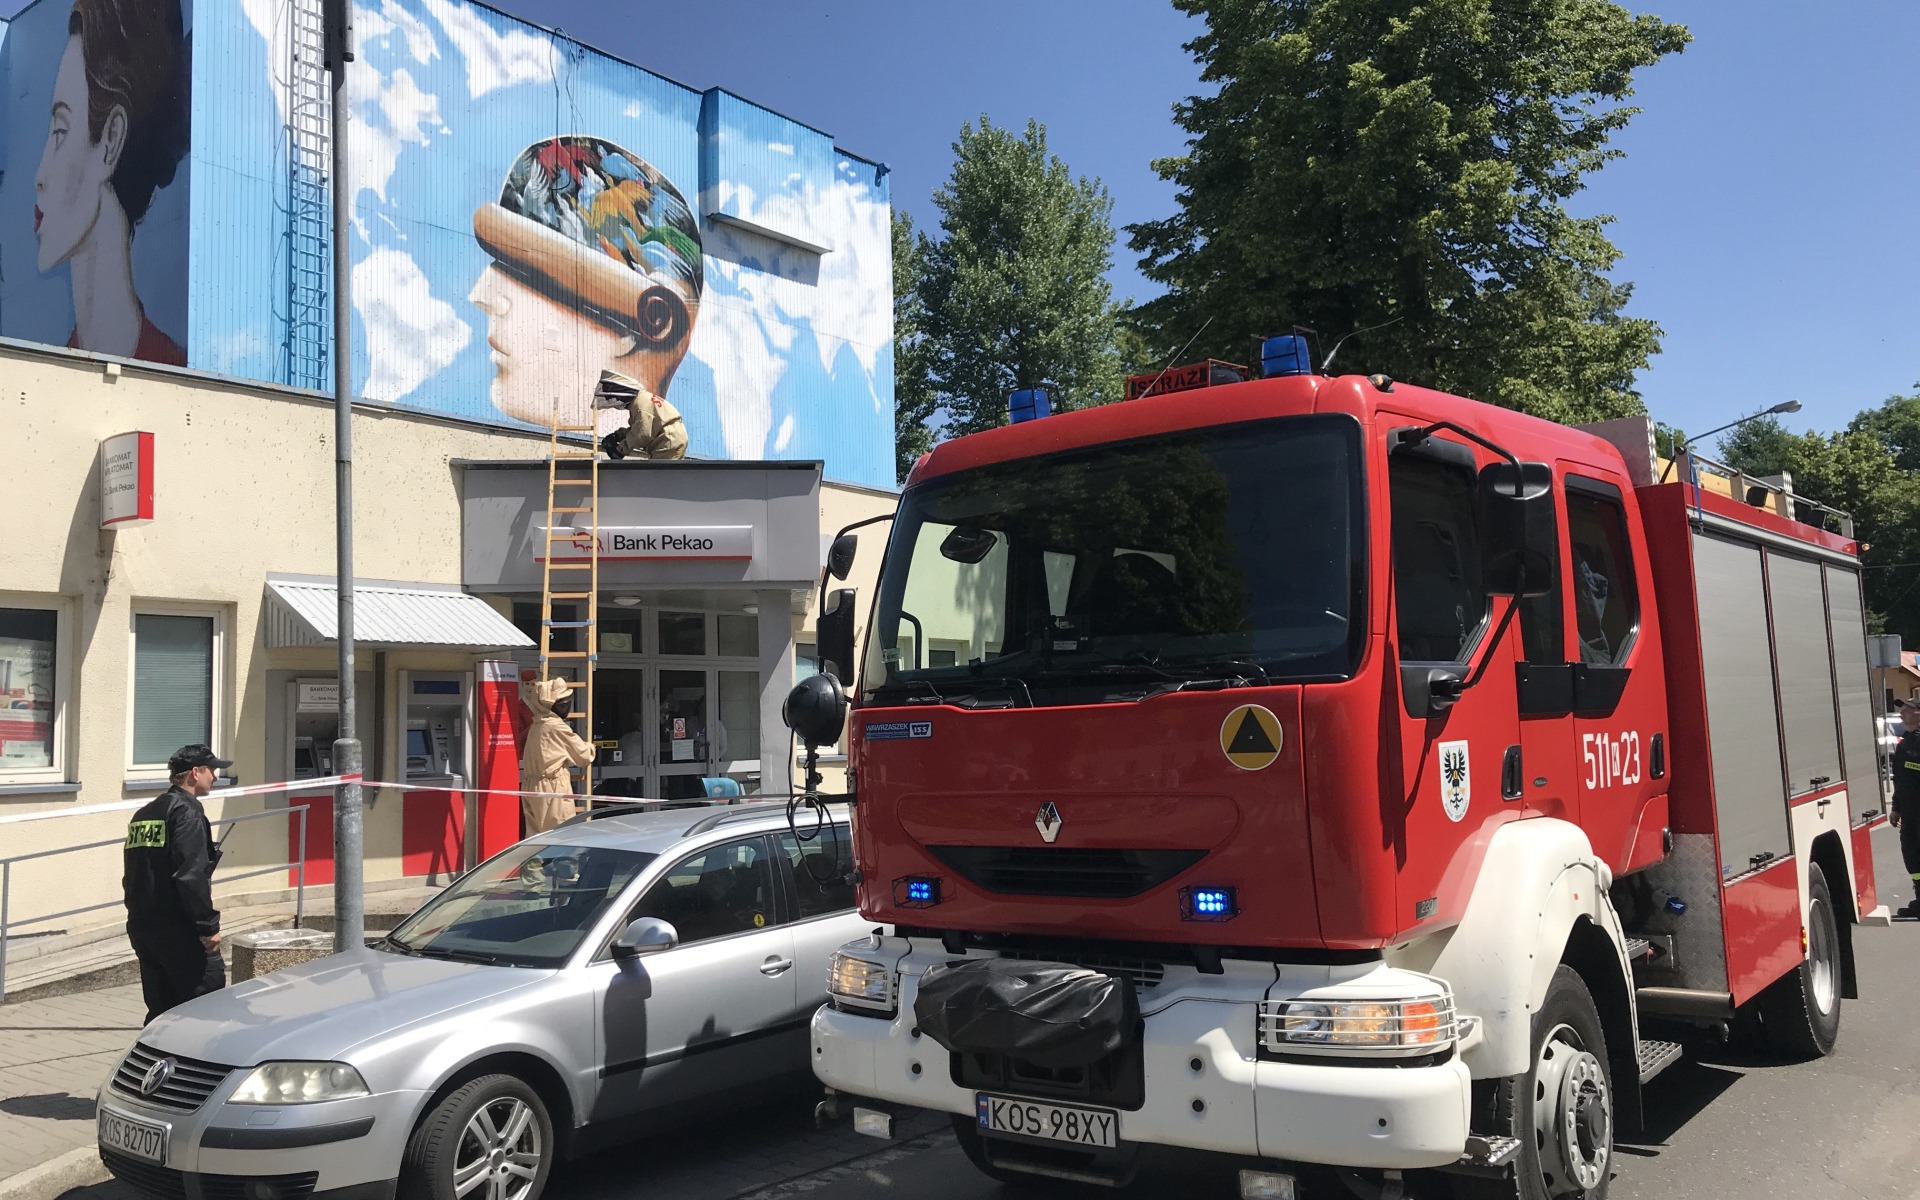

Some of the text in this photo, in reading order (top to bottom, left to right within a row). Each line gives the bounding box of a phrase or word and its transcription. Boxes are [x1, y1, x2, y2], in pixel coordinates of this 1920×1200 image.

[613, 533, 713, 550] Bank Pekao
[979, 1115, 988, 1125] PL
[992, 1100, 1111, 1145] KOS 98XY
[103, 1115, 161, 1157] KOS 82707
